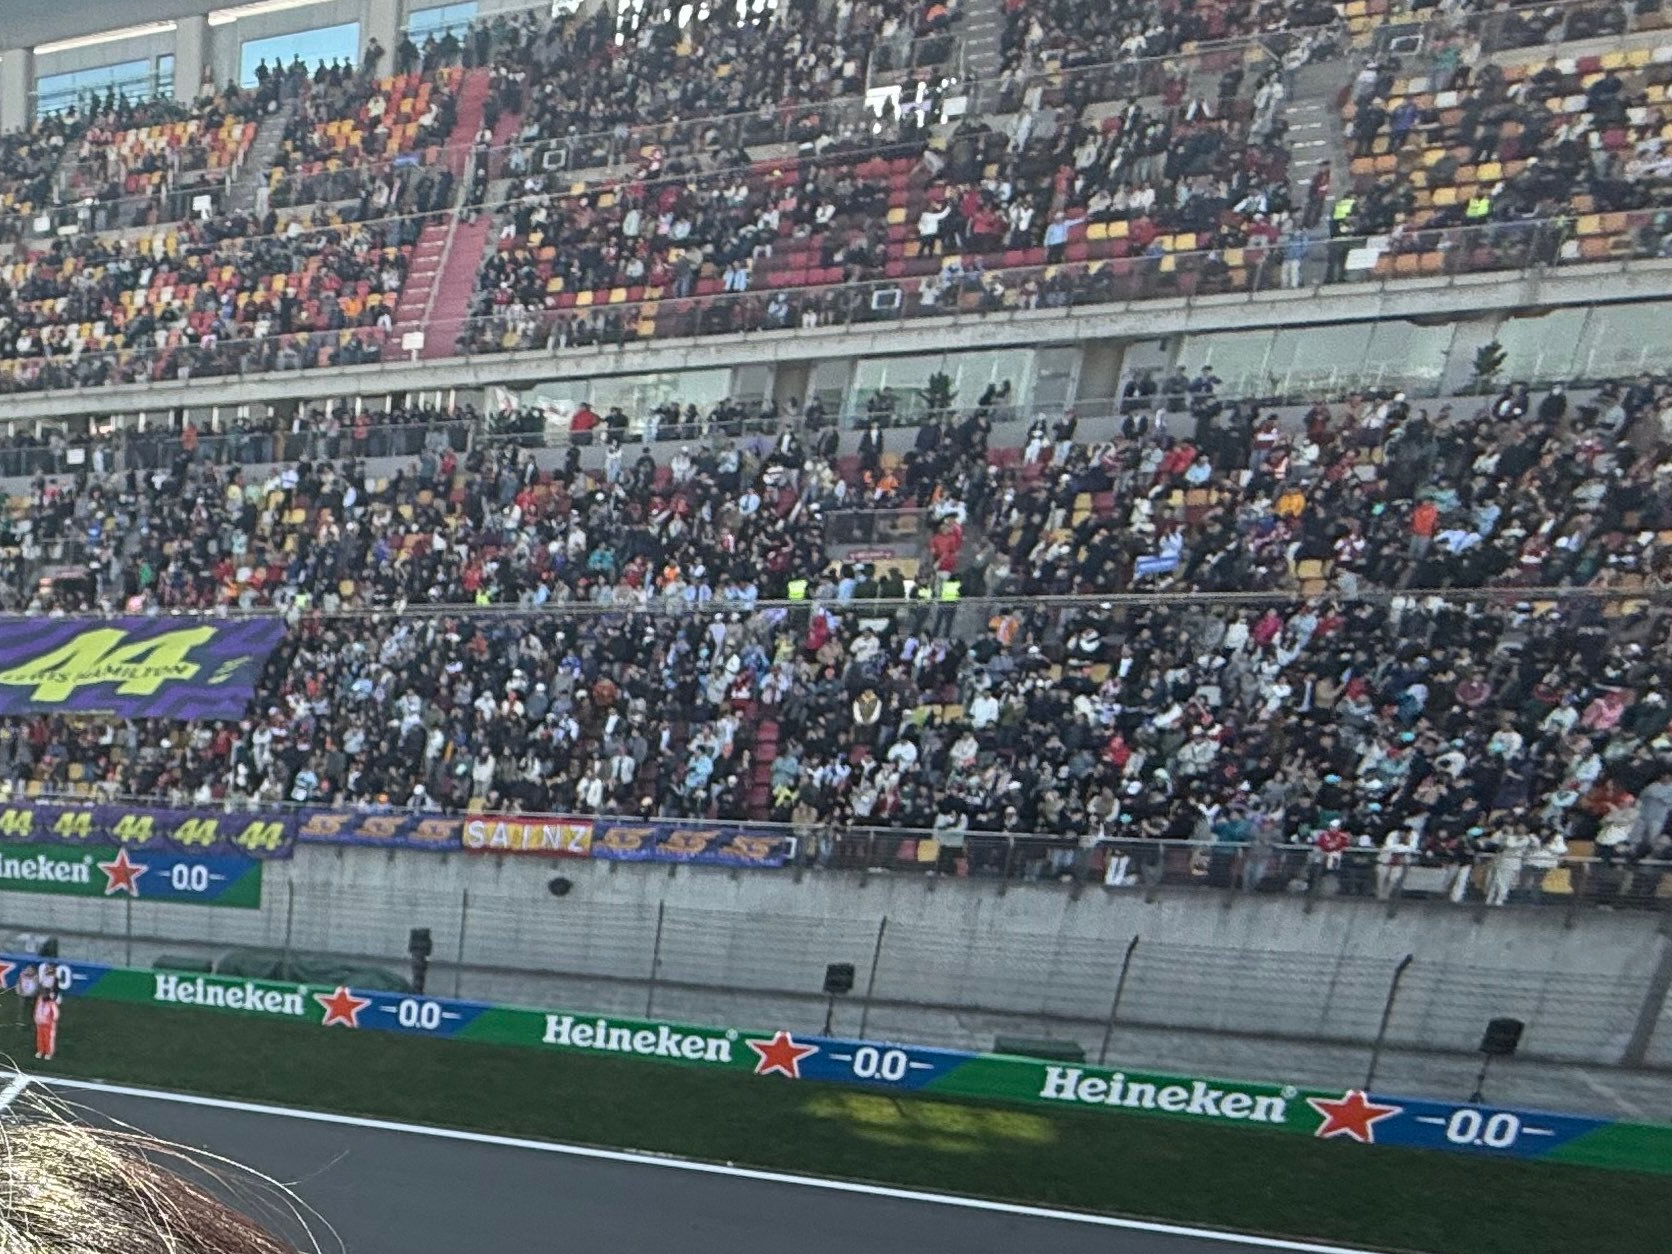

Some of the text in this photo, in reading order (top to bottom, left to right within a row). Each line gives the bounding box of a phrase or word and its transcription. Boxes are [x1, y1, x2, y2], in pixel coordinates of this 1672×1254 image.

[54, 811, 92, 837] 44
[113, 814, 154, 842] 44
[173, 818, 218, 846] 44
[236, 820, 284, 850] 44
[467, 818, 585, 853] SAINZ
[155, 974, 305, 1016] Heineken
[543, 1013, 732, 1063] Heineken
[1039, 1065, 1287, 1124] Heineken
